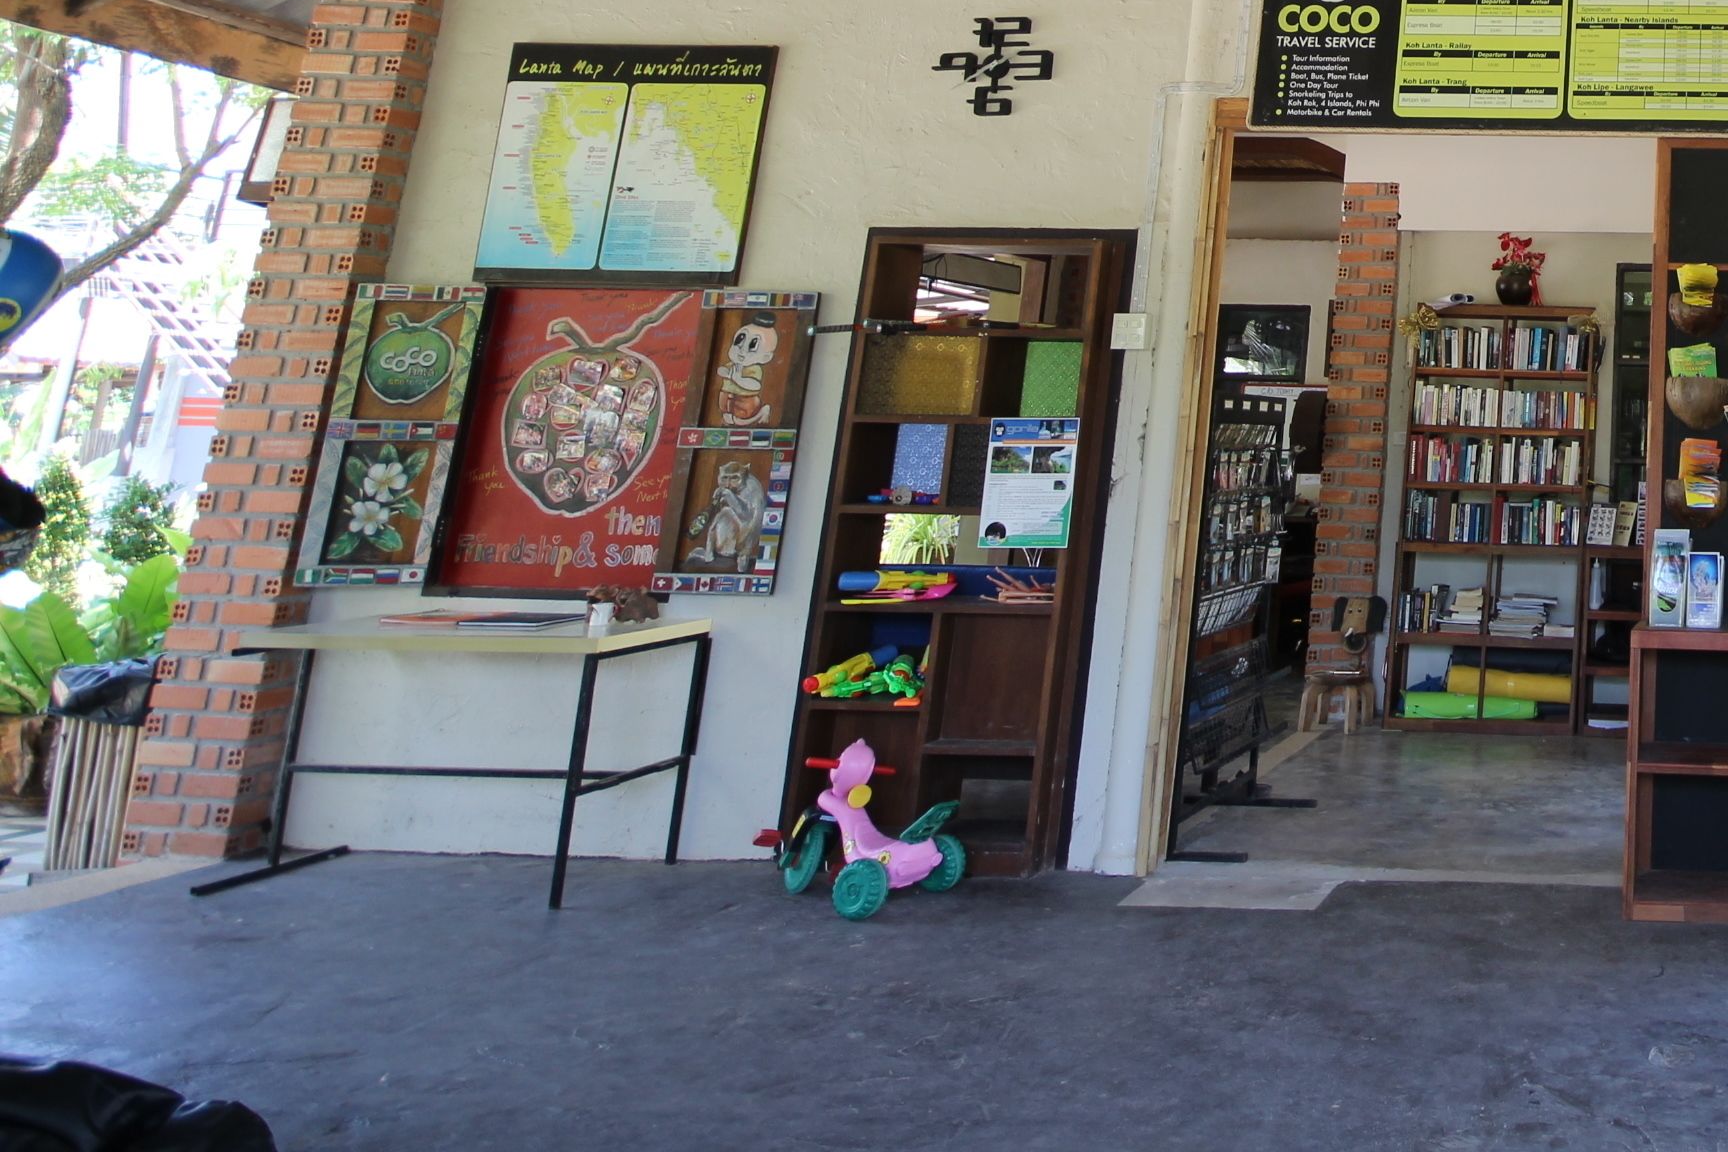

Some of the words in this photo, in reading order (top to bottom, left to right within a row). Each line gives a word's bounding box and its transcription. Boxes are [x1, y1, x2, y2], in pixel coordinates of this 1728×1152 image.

[972, 17, 1032, 48] 12
[1278, 4, 1380, 34] COCO
[1276, 36, 1320, 47] TRAVEL
[1325, 37, 1376, 48] SERVICE
[519, 59, 563, 74] Lanta
[572, 59, 604, 80] Map
[633, 50, 763, 77] แผนที่เกาะลันตา
[931, 52, 978, 82] 9
[1014, 50, 1054, 81] 3
[966, 85, 1013, 116] 6
[1288, 90, 1326, 99] Snorkeling
[1328, 91, 1344, 99] Trips
[1307, 82, 1321, 90] Day
[1303, 99, 1318, 107] Rok,
[454, 534, 573, 578] Friendship
[573, 531, 598, 569] &
